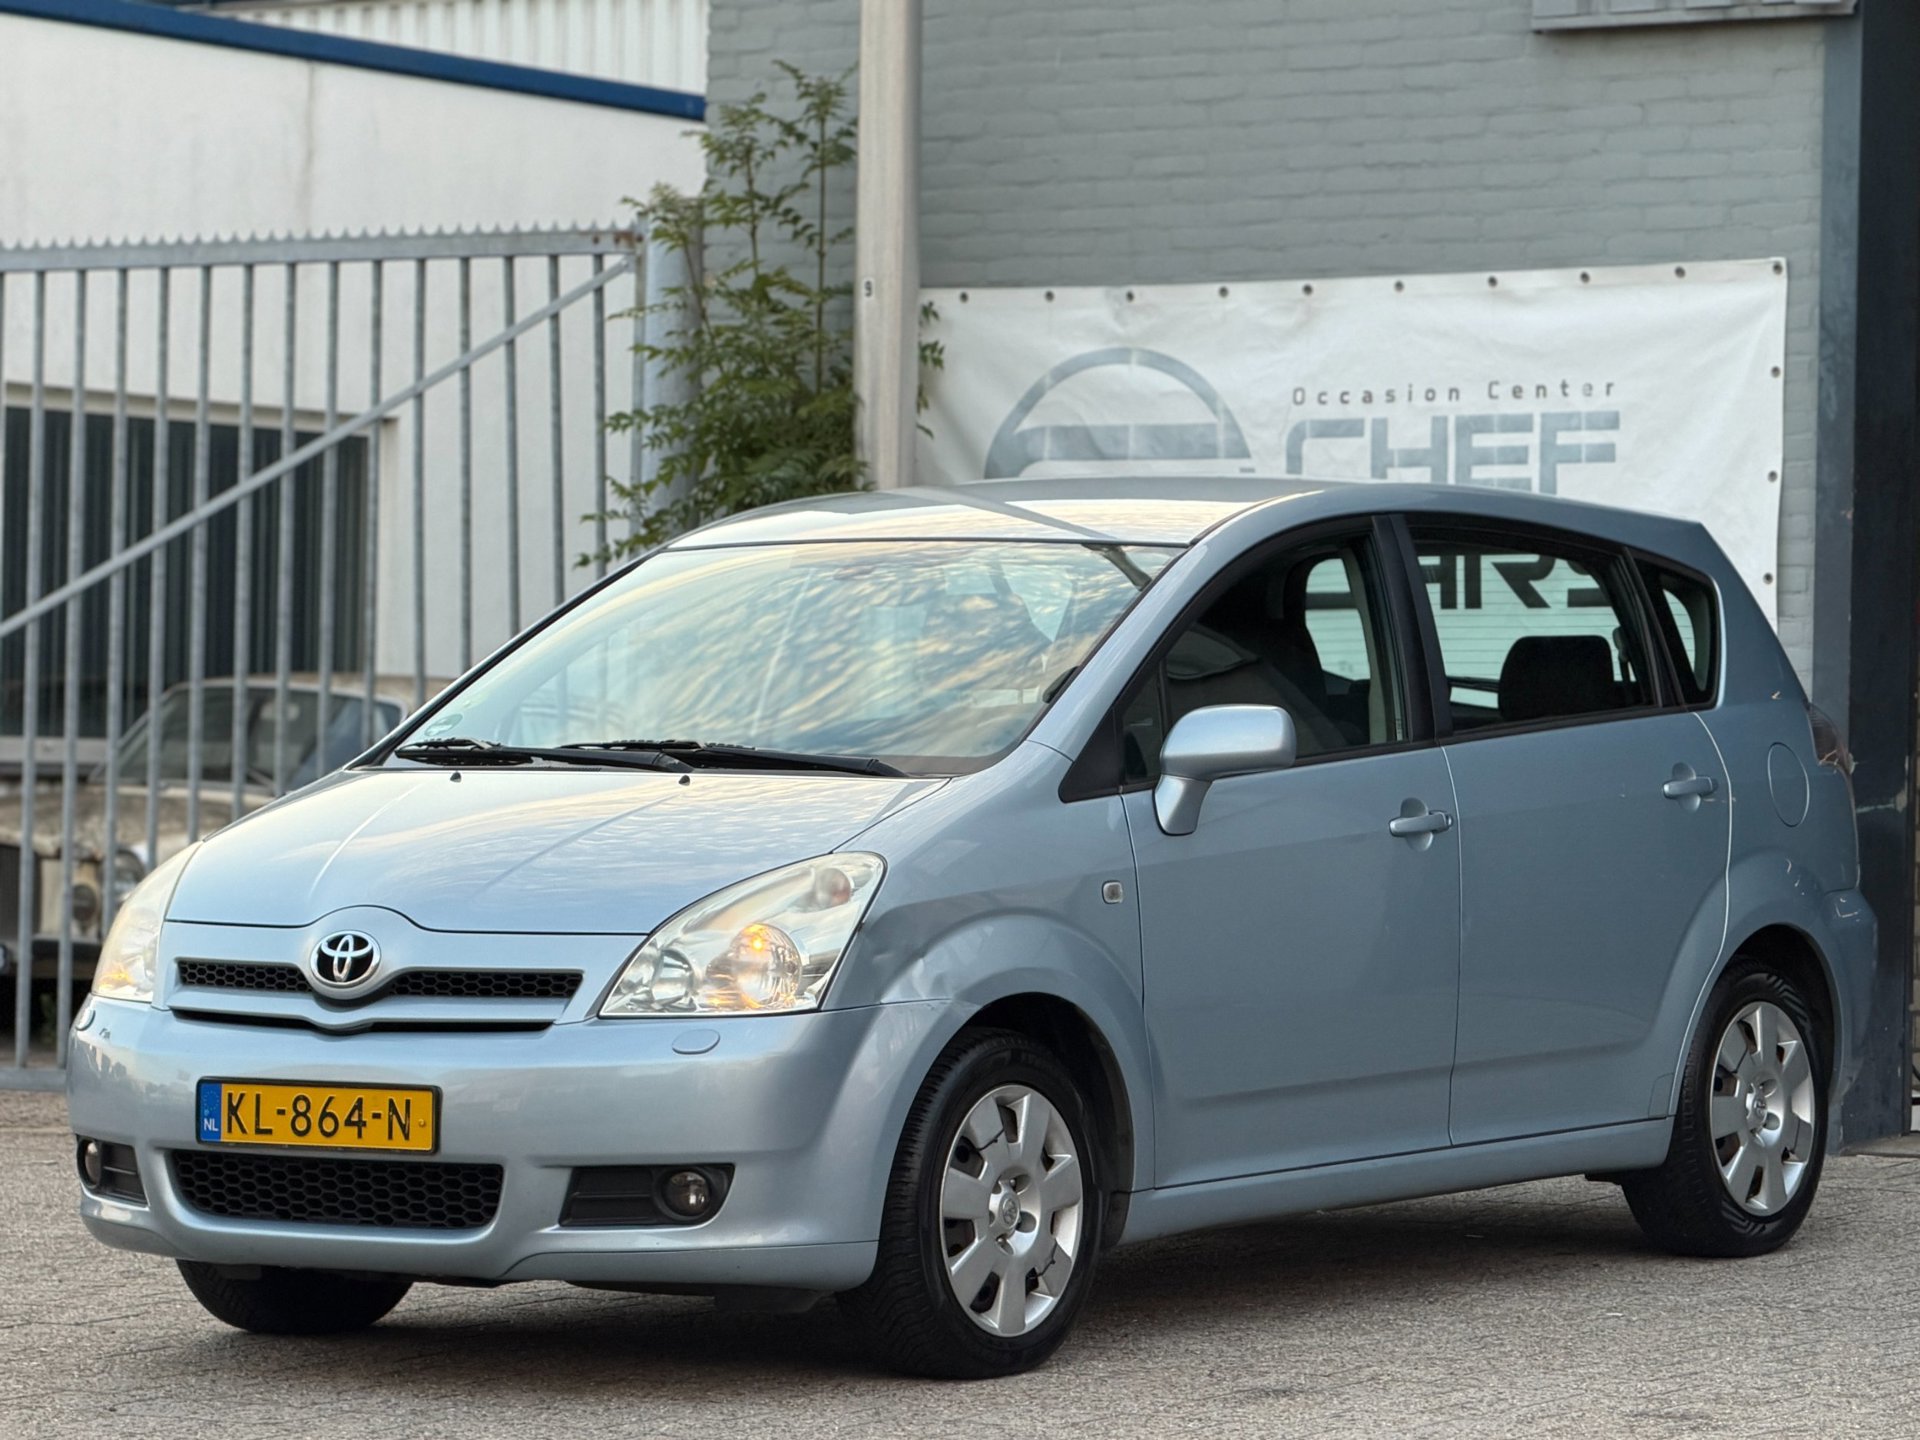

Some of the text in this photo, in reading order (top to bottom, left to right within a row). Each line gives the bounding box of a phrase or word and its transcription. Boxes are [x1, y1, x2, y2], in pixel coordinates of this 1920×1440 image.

[1292, 379, 1615, 406] Occasion Center
[203, 1117, 219, 1132] NL
[227, 1091, 412, 1141] KL-864-N
